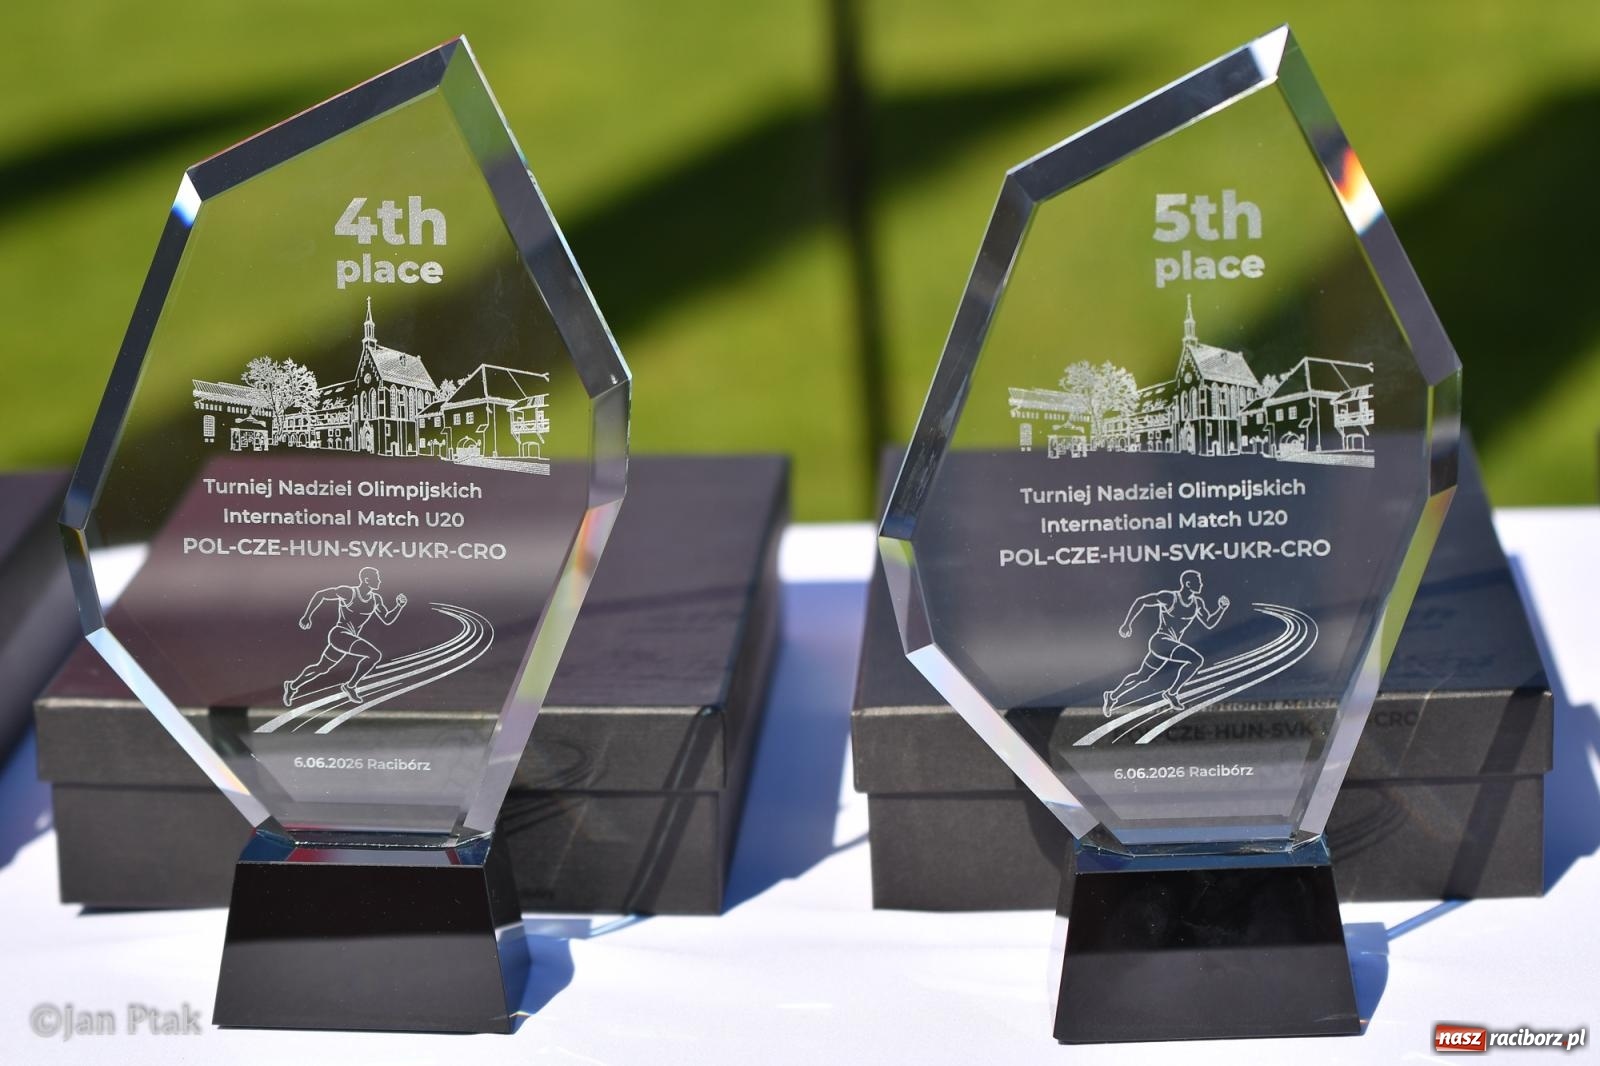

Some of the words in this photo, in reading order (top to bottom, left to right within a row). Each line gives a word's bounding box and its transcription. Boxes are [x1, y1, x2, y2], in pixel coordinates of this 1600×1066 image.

[334, 195, 447, 245] 4th
[1152, 188, 1262, 243] 5th
[336, 252, 444, 290] place
[1155, 249, 1266, 289] place
[203, 478, 272, 498] Turniej
[278, 479, 352, 497] Nadziei
[357, 480, 483, 501] Olimpijskich
[1020, 485, 1091, 505] Turniej
[1098, 482, 1173, 501] Nadziei
[1178, 479, 1306, 501] Olimpijskich
[223, 508, 351, 526] International
[357, 510, 419, 528] Match
[425, 512, 465, 528] U20
[1041, 512, 1172, 534] International
[1179, 510, 1242, 529] Match
[1248, 509, 1288, 526] U20
[183, 537, 507, 560] POL-CZE-HUN-SVK-UKR-CRO
[1000, 539, 1332, 567] POL-CZE-HUN-SVK-UKR-CRO
[293, 756, 364, 769] 6.06.2026
[367, 758, 432, 771] Racibórz
[1113, 766, 1186, 780] 6.06.2026
[1189, 764, 1255, 777] Racibórz
